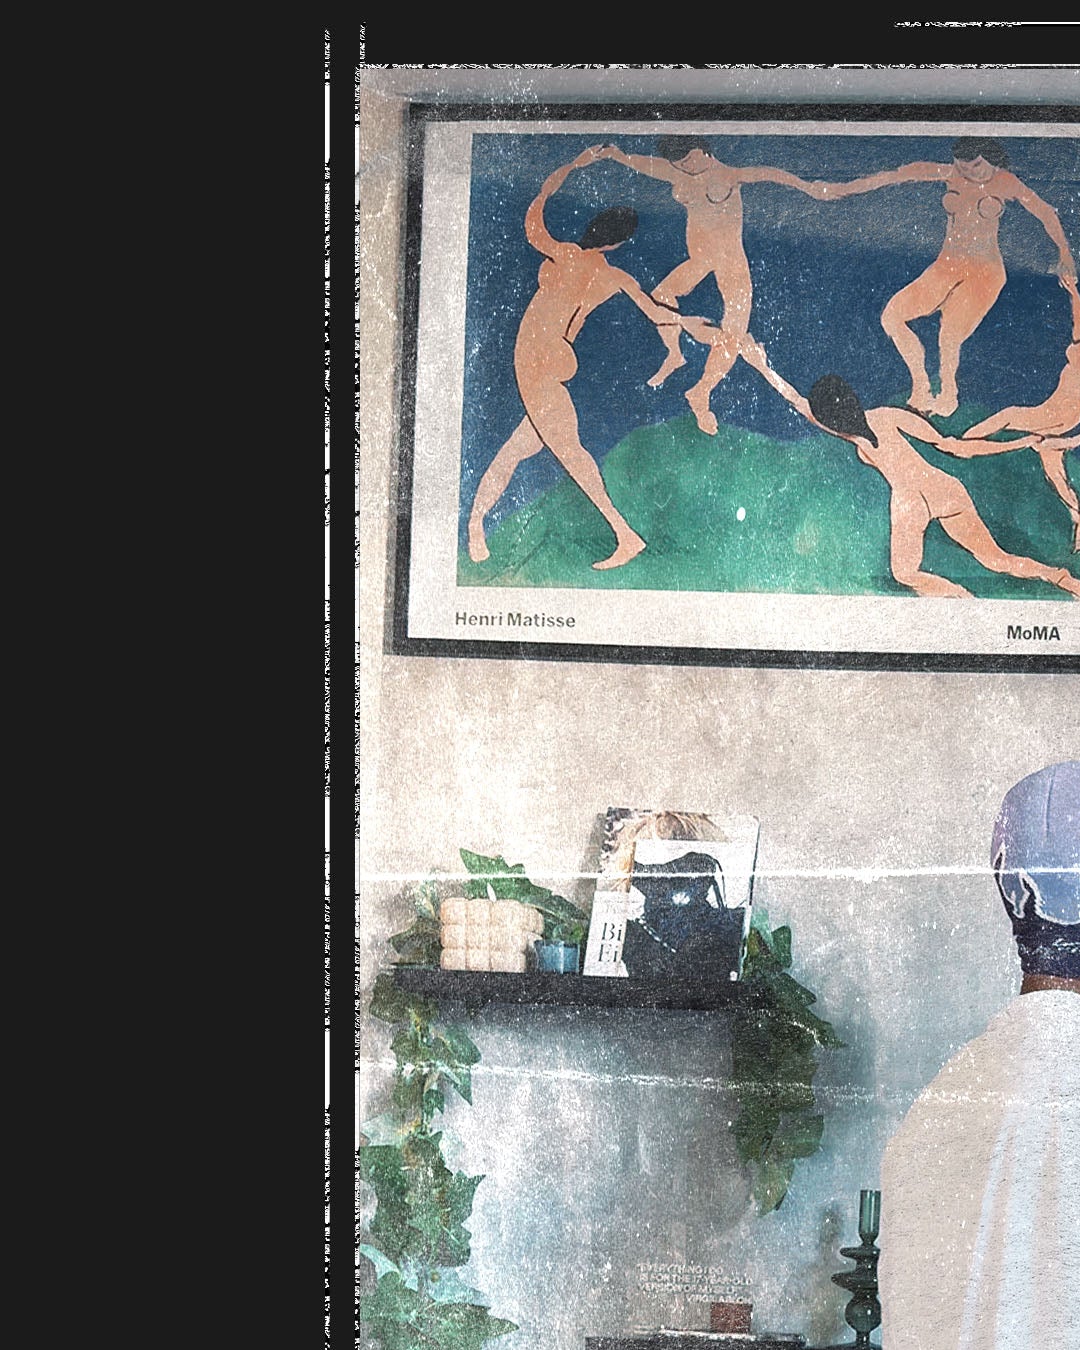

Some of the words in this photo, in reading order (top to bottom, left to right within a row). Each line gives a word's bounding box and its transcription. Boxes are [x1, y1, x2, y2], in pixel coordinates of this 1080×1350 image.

[455, 611, 503, 626] Henri
[506, 612, 576, 628] Matisse
[1007, 624, 1061, 641] MoMA
